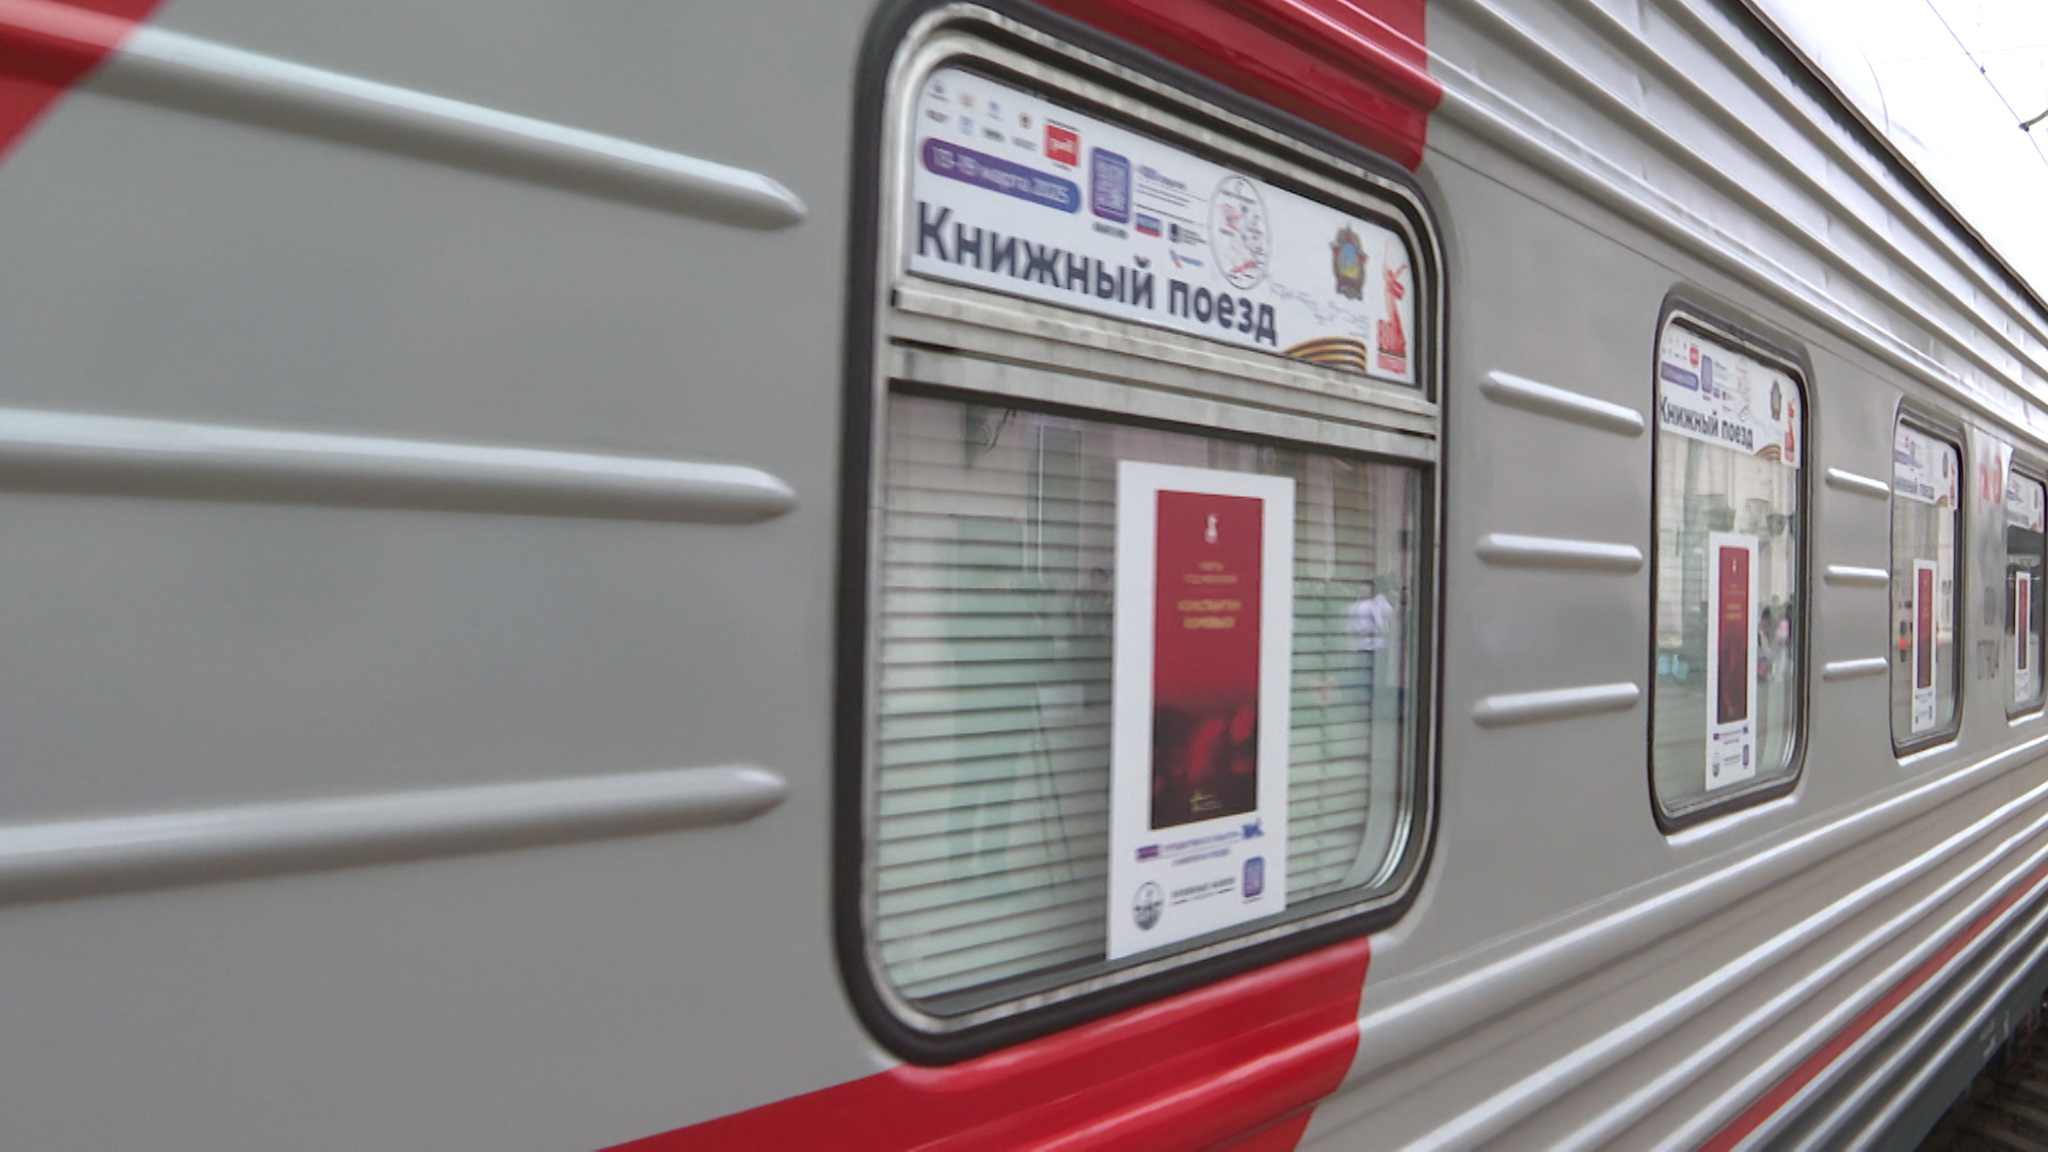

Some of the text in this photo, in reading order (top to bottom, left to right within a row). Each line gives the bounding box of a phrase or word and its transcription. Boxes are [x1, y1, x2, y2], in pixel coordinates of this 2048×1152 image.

[918, 201, 1278, 347] Книжный поезд
[1660, 395, 1719, 437] Книжный
[1721, 419, 1754, 451] поезд
